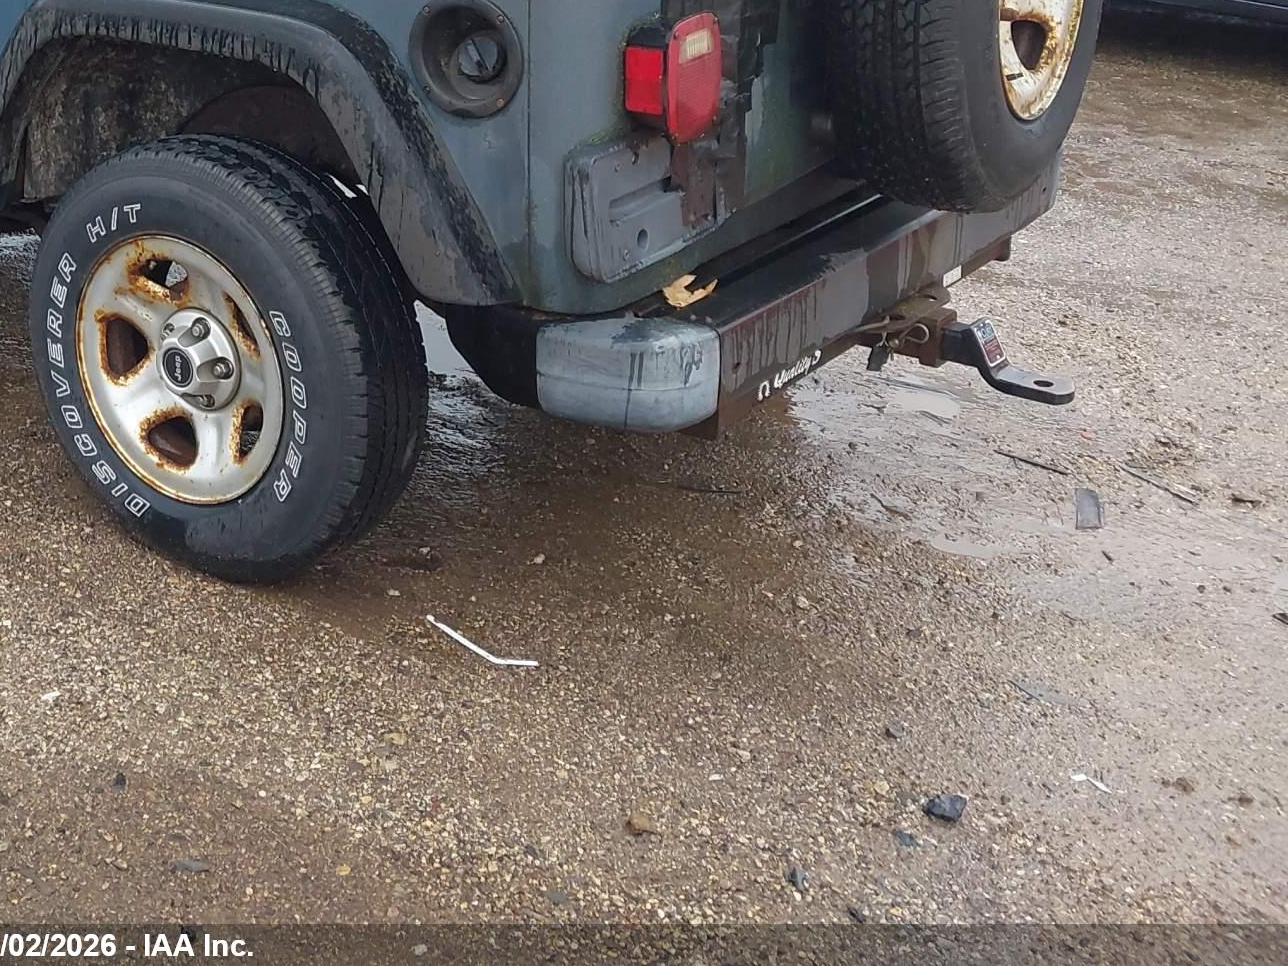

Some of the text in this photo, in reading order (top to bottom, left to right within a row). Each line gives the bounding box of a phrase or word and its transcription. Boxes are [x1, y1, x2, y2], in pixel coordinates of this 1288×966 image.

[85, 203, 142, 244] H/T
[46, 252, 151, 518] DISCOVERER
[174, 355, 183, 382] Jeep
[268, 310, 308, 503] COOPER
